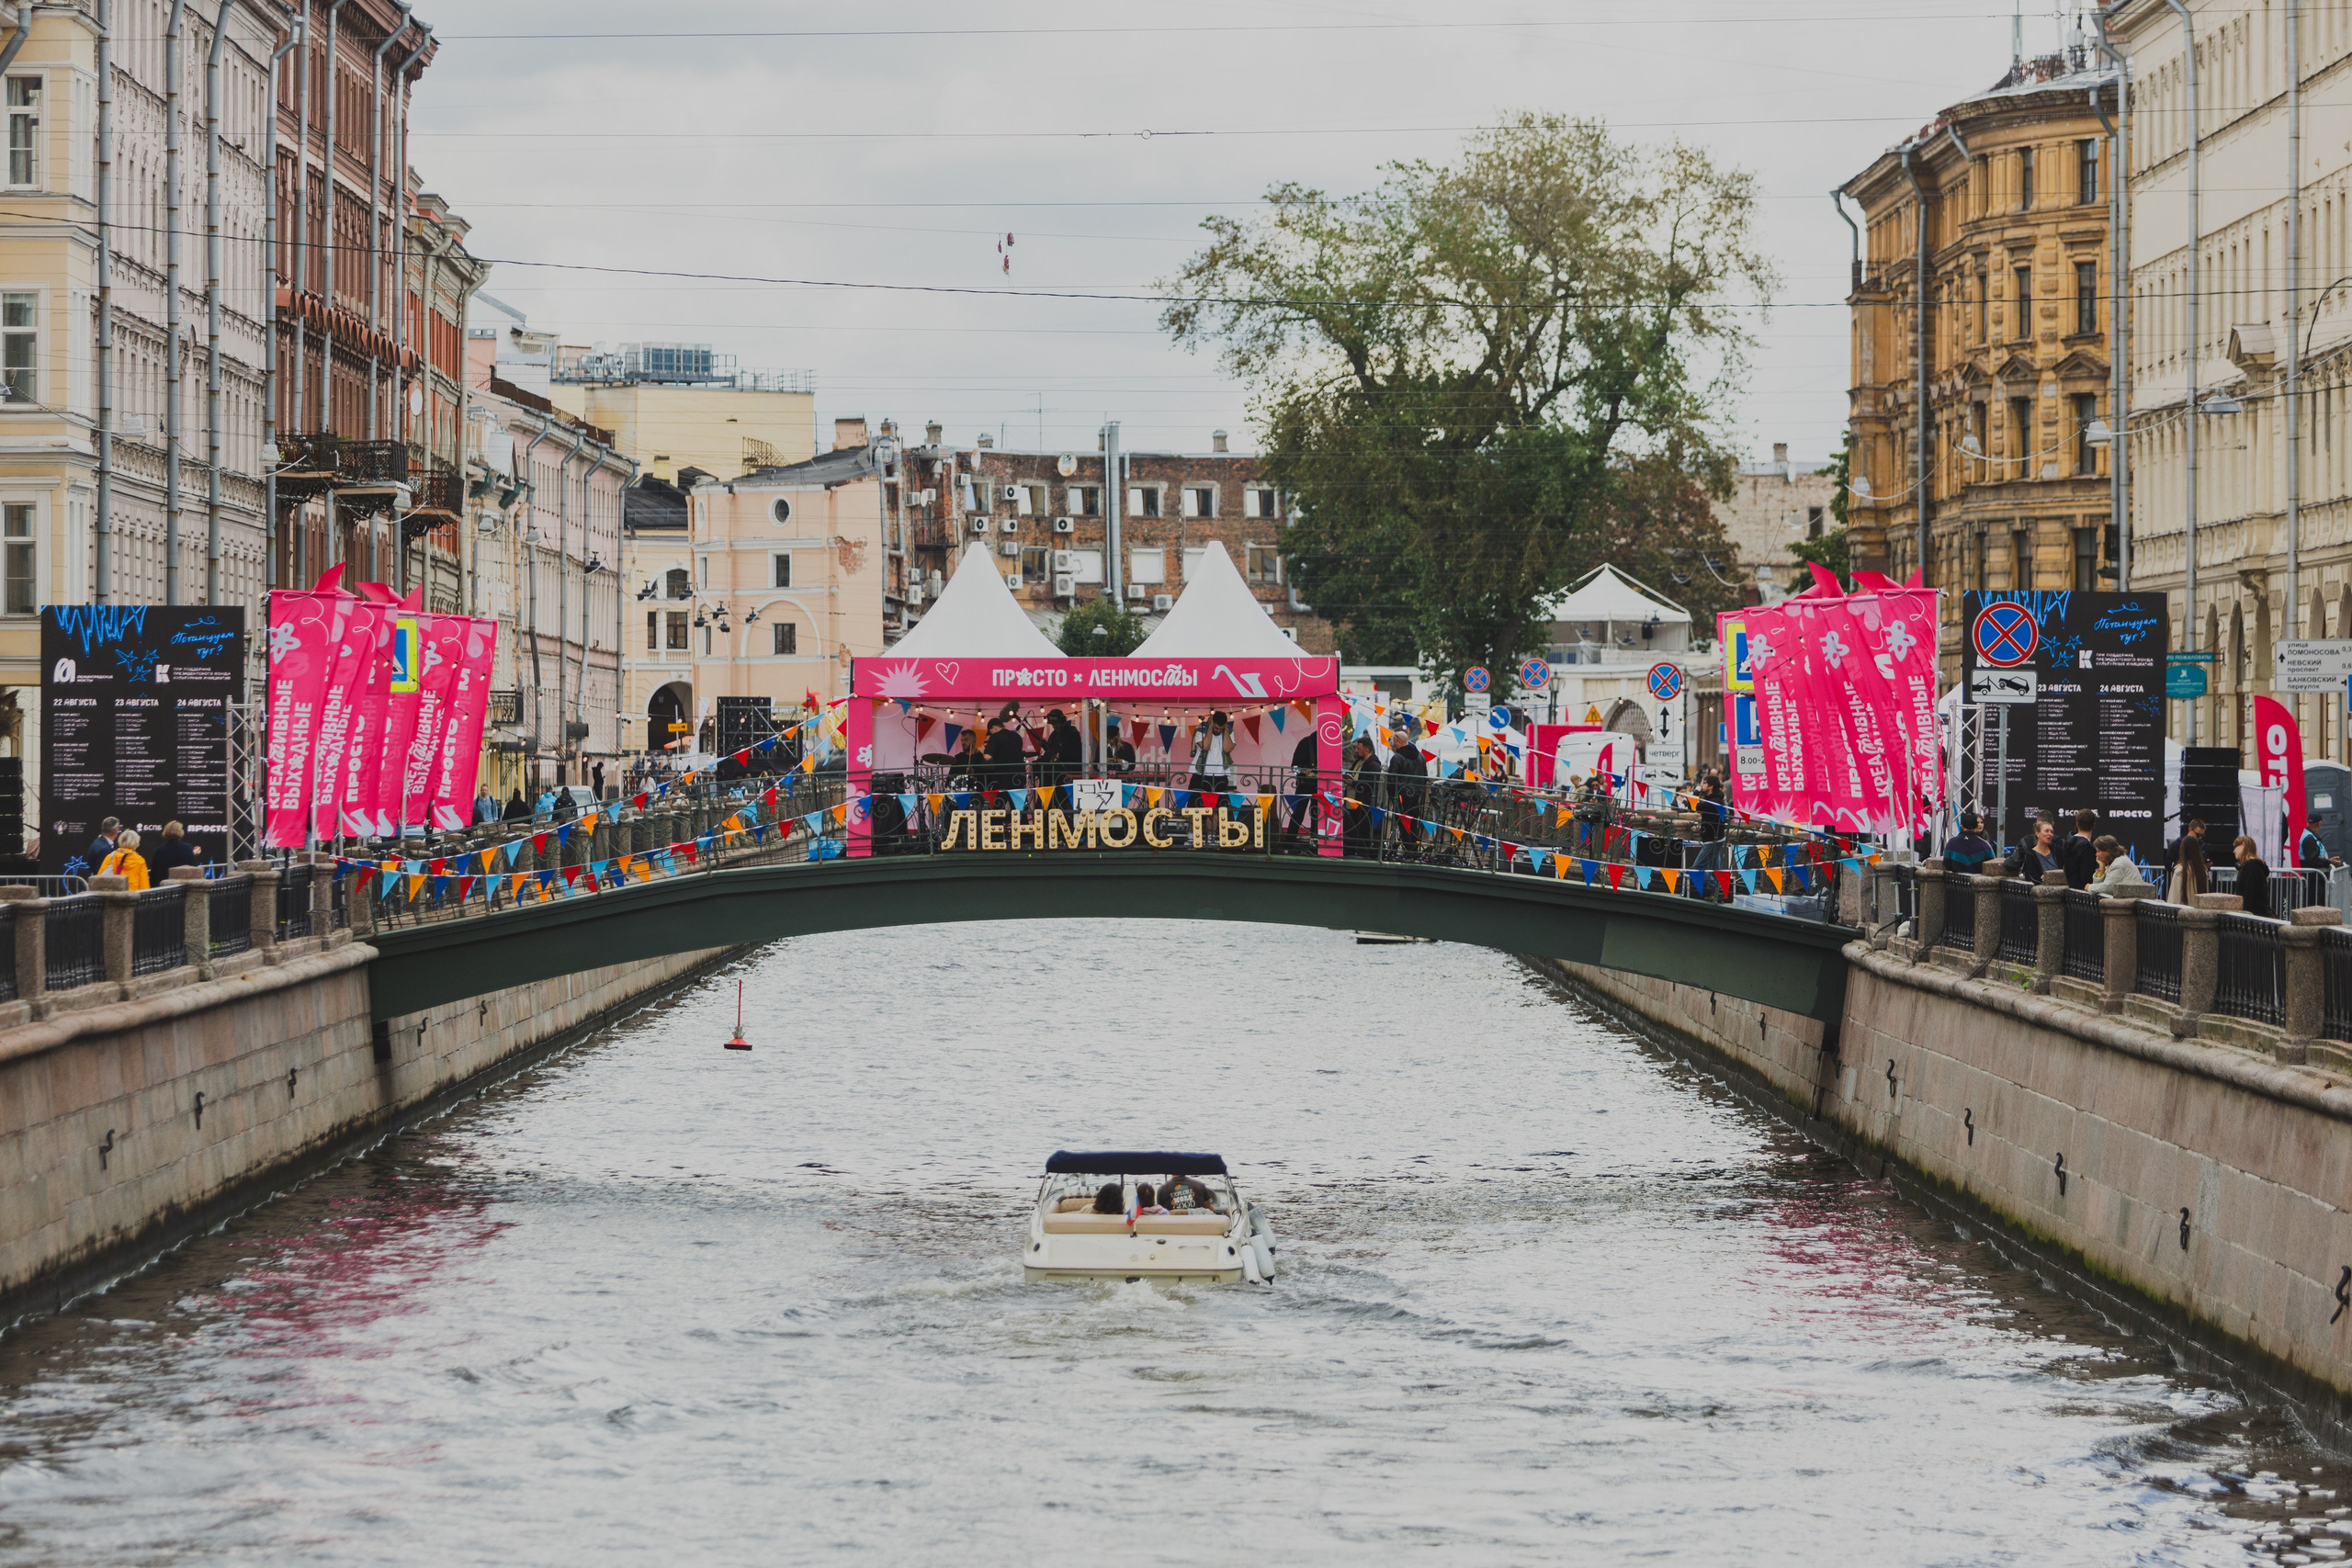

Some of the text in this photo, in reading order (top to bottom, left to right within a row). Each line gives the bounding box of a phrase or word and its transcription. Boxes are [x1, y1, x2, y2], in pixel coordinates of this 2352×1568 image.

[2093, 618, 2157, 631] Потанцуем
[170, 631, 234, 645] Потанцуем
[2119, 630, 2146, 645] тут?
[197, 645, 223, 659] тут?
[992, 663, 1197, 687] ПРОСТО ЛЕНМОСТЫ
[2287, 675, 2337, 683] БАНКОВСКИЙ
[2048, 684, 2081, 693] АВГУСТА
[2110, 684, 2144, 693] АВГУСТА
[437, 717, 458, 798] ПРОСТО
[1648, 749, 1680, 759] четверг
[941, 807, 1264, 851] ЛЕНМОСТЫ
[1170, 1189, 1193, 1197] EXPLORE
[1173, 1194, 1193, 1203] MORE
[1172, 1200, 1196, 1209] GOOD
